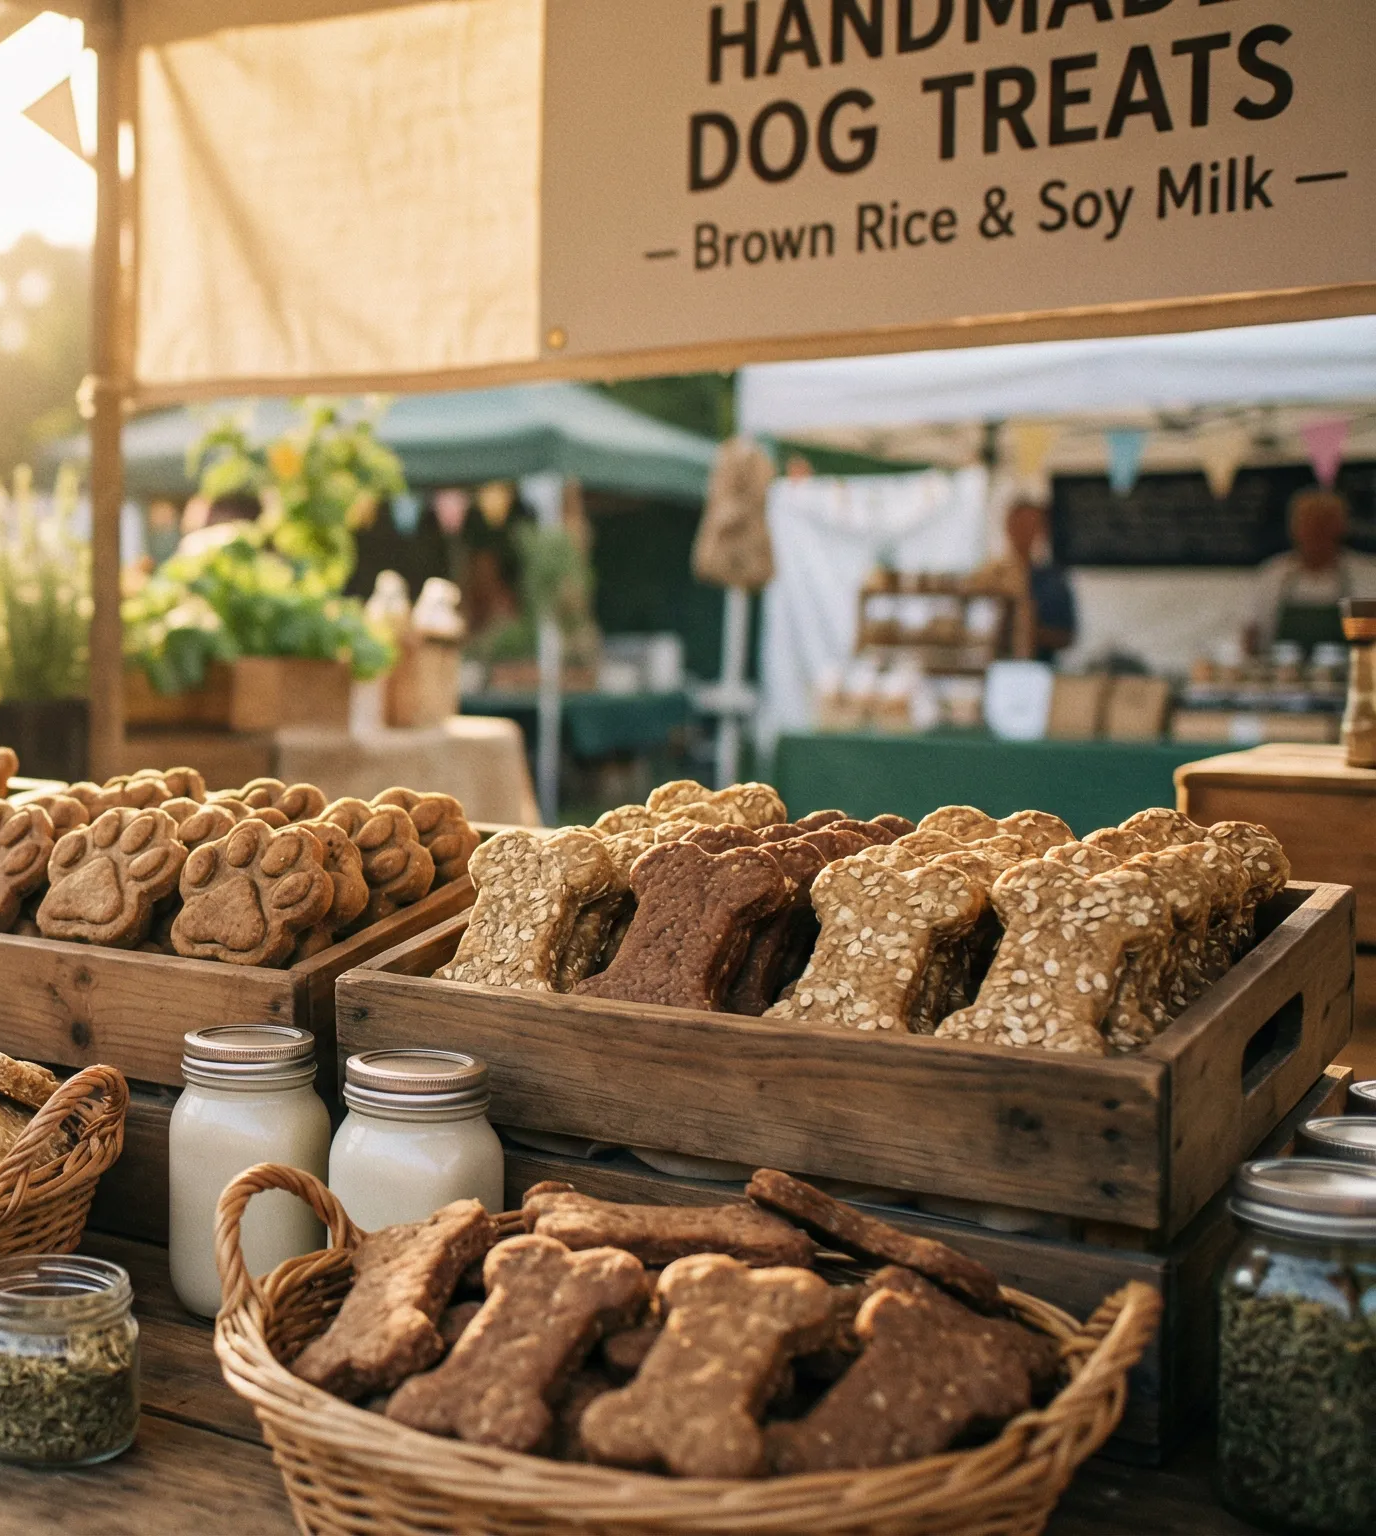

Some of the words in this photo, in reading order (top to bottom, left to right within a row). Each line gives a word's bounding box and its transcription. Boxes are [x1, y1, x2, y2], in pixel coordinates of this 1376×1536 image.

[708, 0, 1240, 85] HAND
[688, 88, 879, 193] DOG
[921, 23, 1295, 162] TREATS
[695, 222, 834, 270] Brown
[856, 201, 958, 253] Rice
[978, 186, 1015, 241] &
[1037, 179, 1135, 242] Soy
[1155, 153, 1275, 221] Milk
